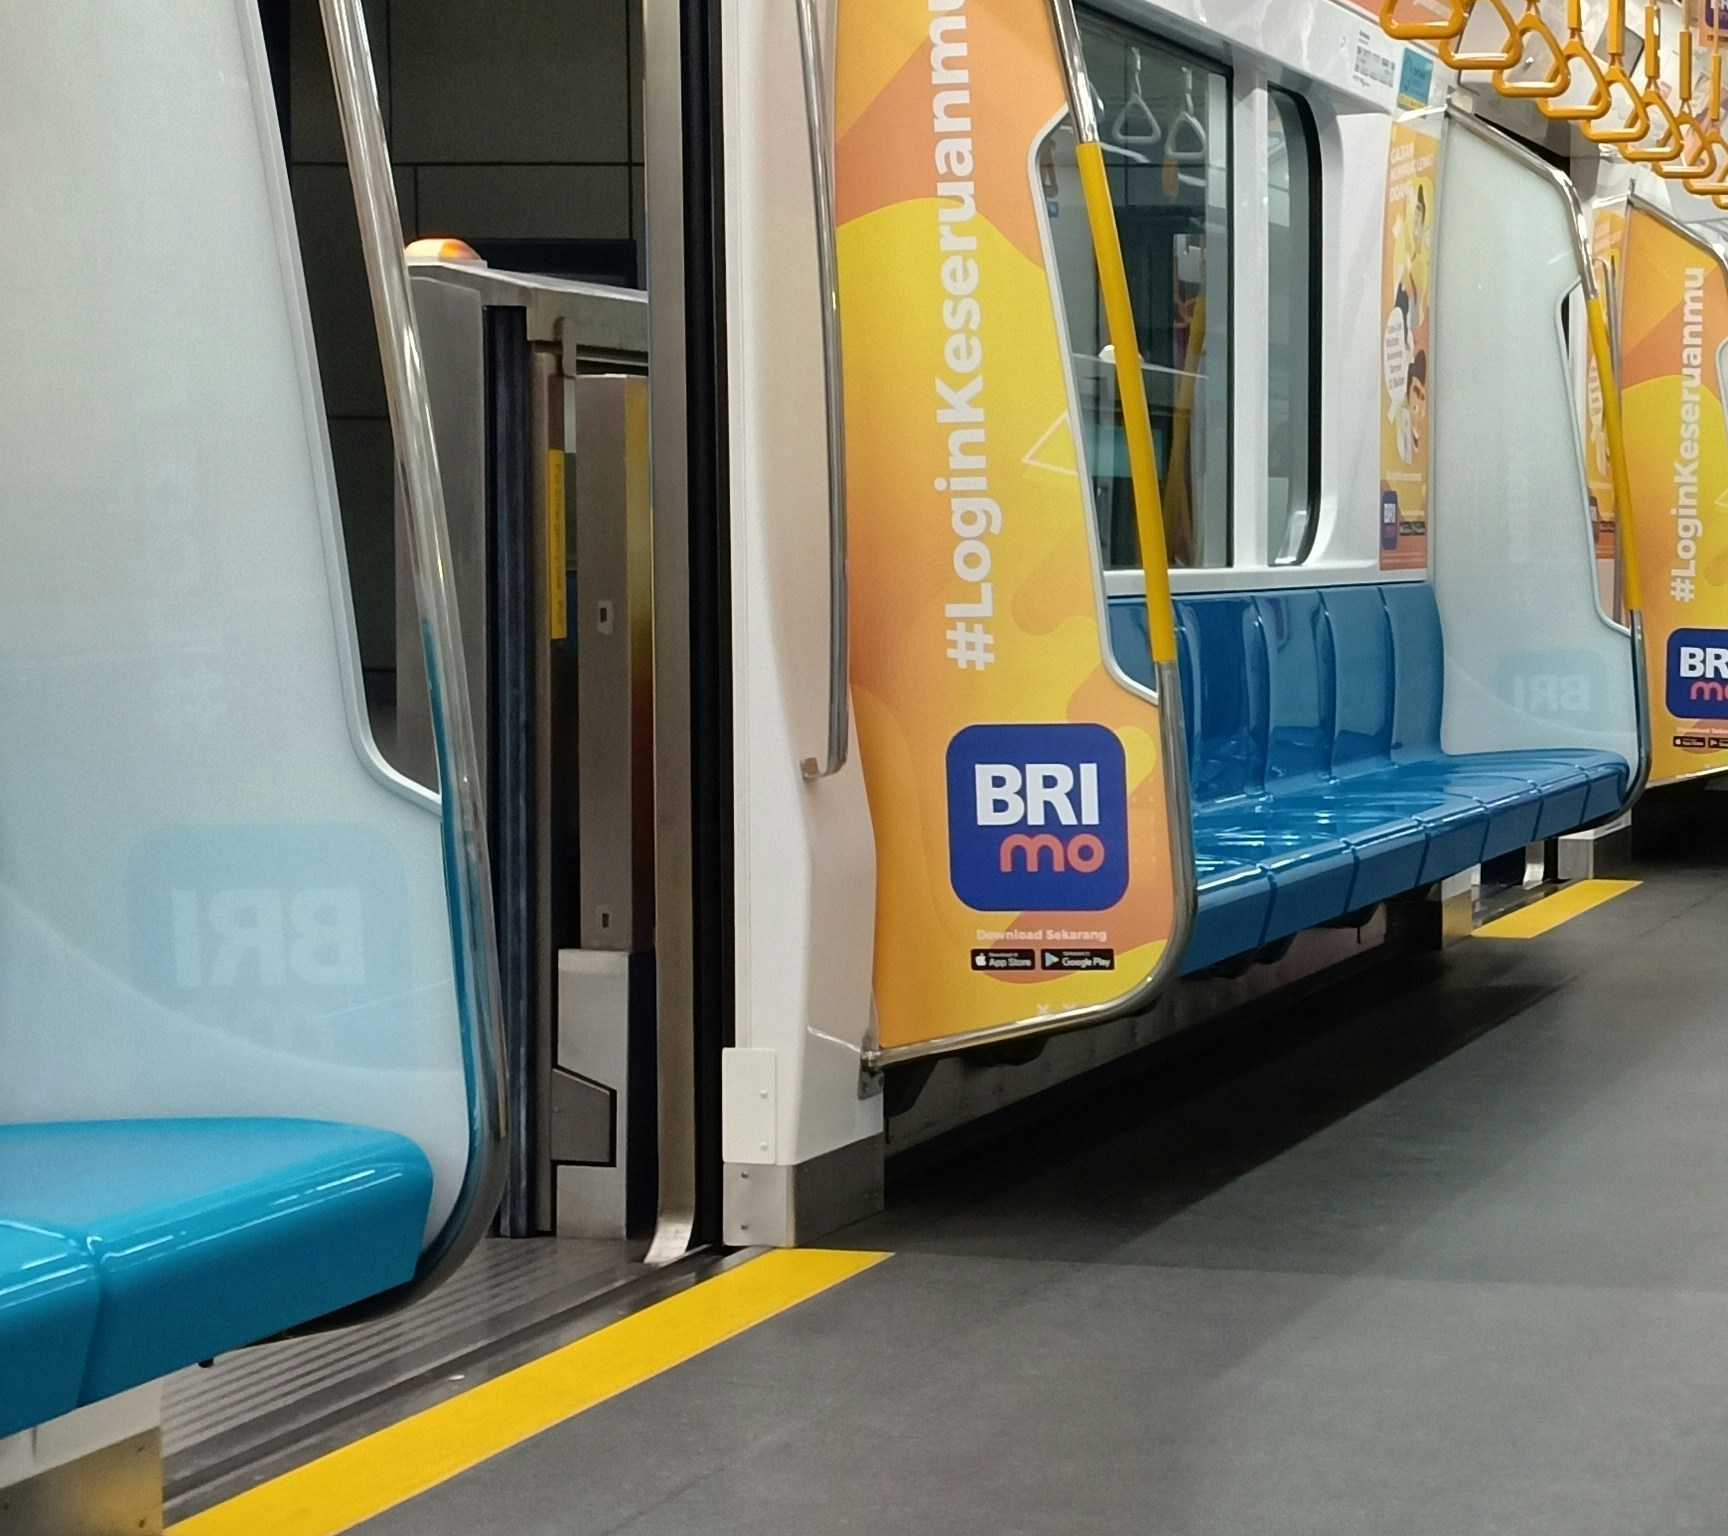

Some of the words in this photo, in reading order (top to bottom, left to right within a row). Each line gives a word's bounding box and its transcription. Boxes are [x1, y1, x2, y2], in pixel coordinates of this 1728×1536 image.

[1670, 267, 1705, 603] #LoginKeseruanmu
[974, 762, 1100, 826] BRI
[999, 833, 1105, 874] mo
[976, 929, 1043, 941] Download
[1045, 929, 1108, 943] Sekarang
[988, 958, 1008, 968] App
[1008, 957, 1033, 967] Store
[1062, 957, 1092, 969] Google
[1092, 957, 1112, 968] Play
